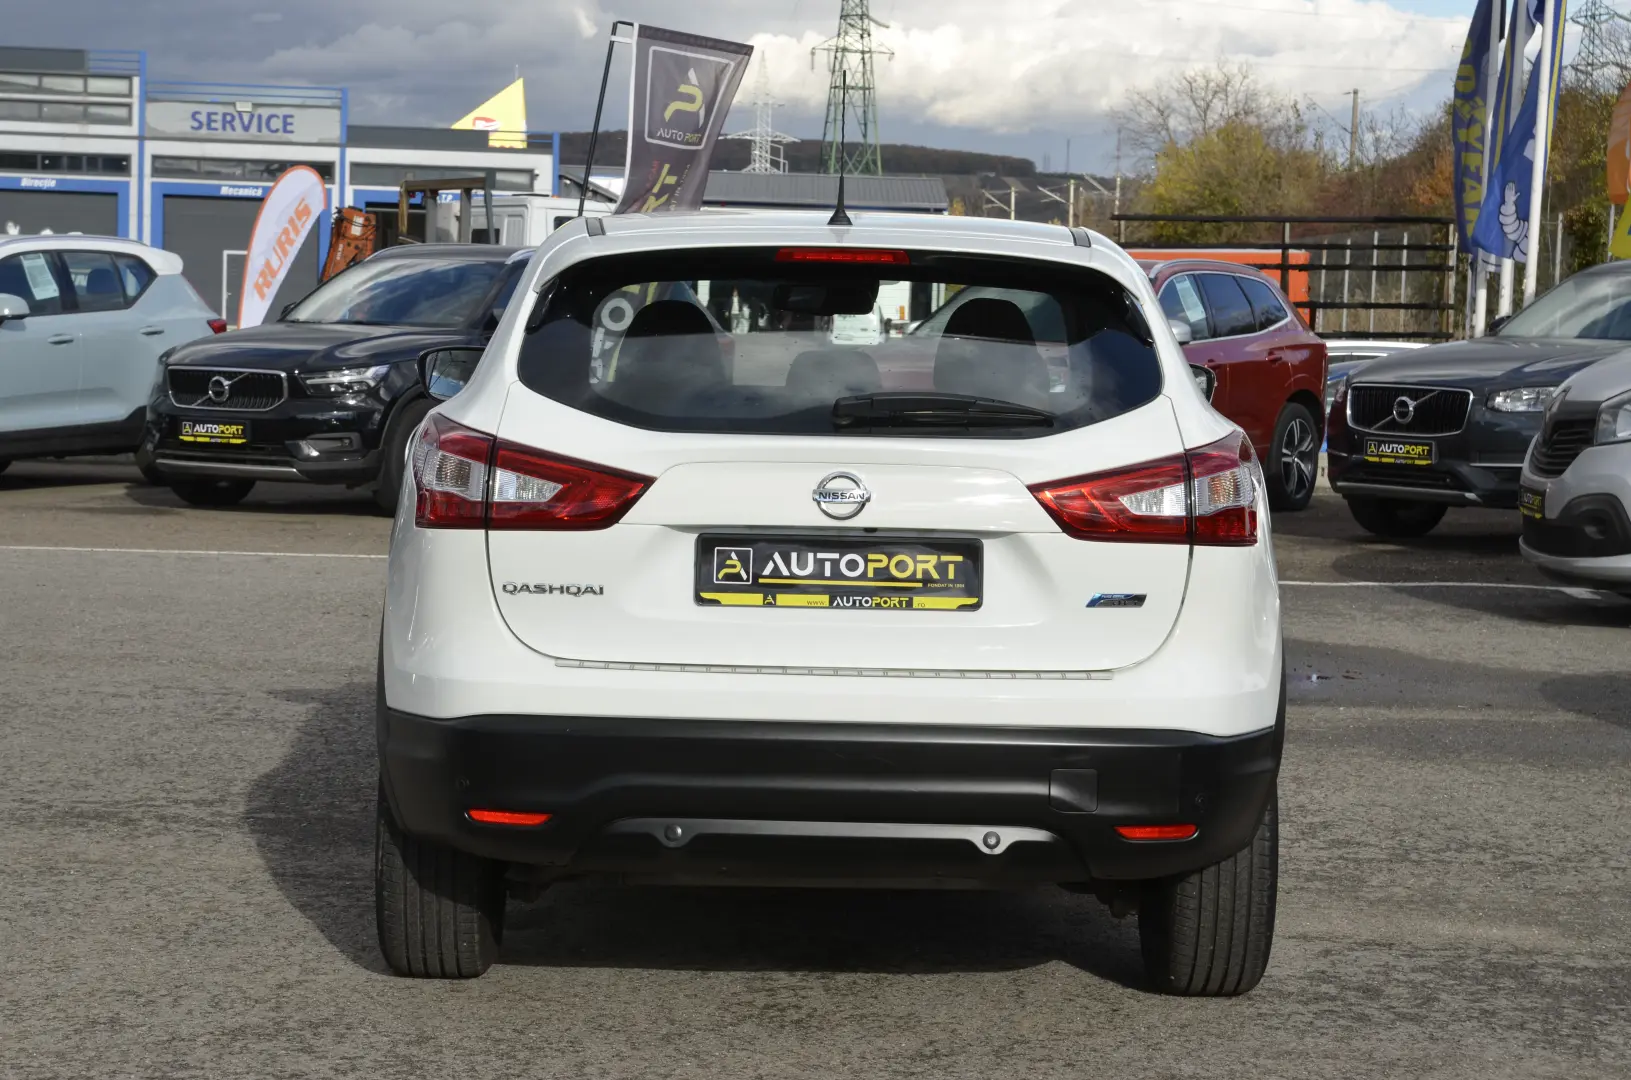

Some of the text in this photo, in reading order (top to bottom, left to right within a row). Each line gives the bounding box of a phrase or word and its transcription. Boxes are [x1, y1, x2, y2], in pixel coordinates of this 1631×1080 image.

[190, 111, 296, 134] SERVICE
[656, 128, 684, 141] AUTO
[253, 197, 312, 302] RURIS
[193, 424, 244, 435] AUTOPORT
[1378, 443, 1430, 456] AUTOPORT
[818, 491, 866, 500] NISSAN
[761, 551, 964, 580] AUTOPORT
[502, 581, 604, 597] QASHQAI
[832, 596, 909, 608] AUTOPORT
